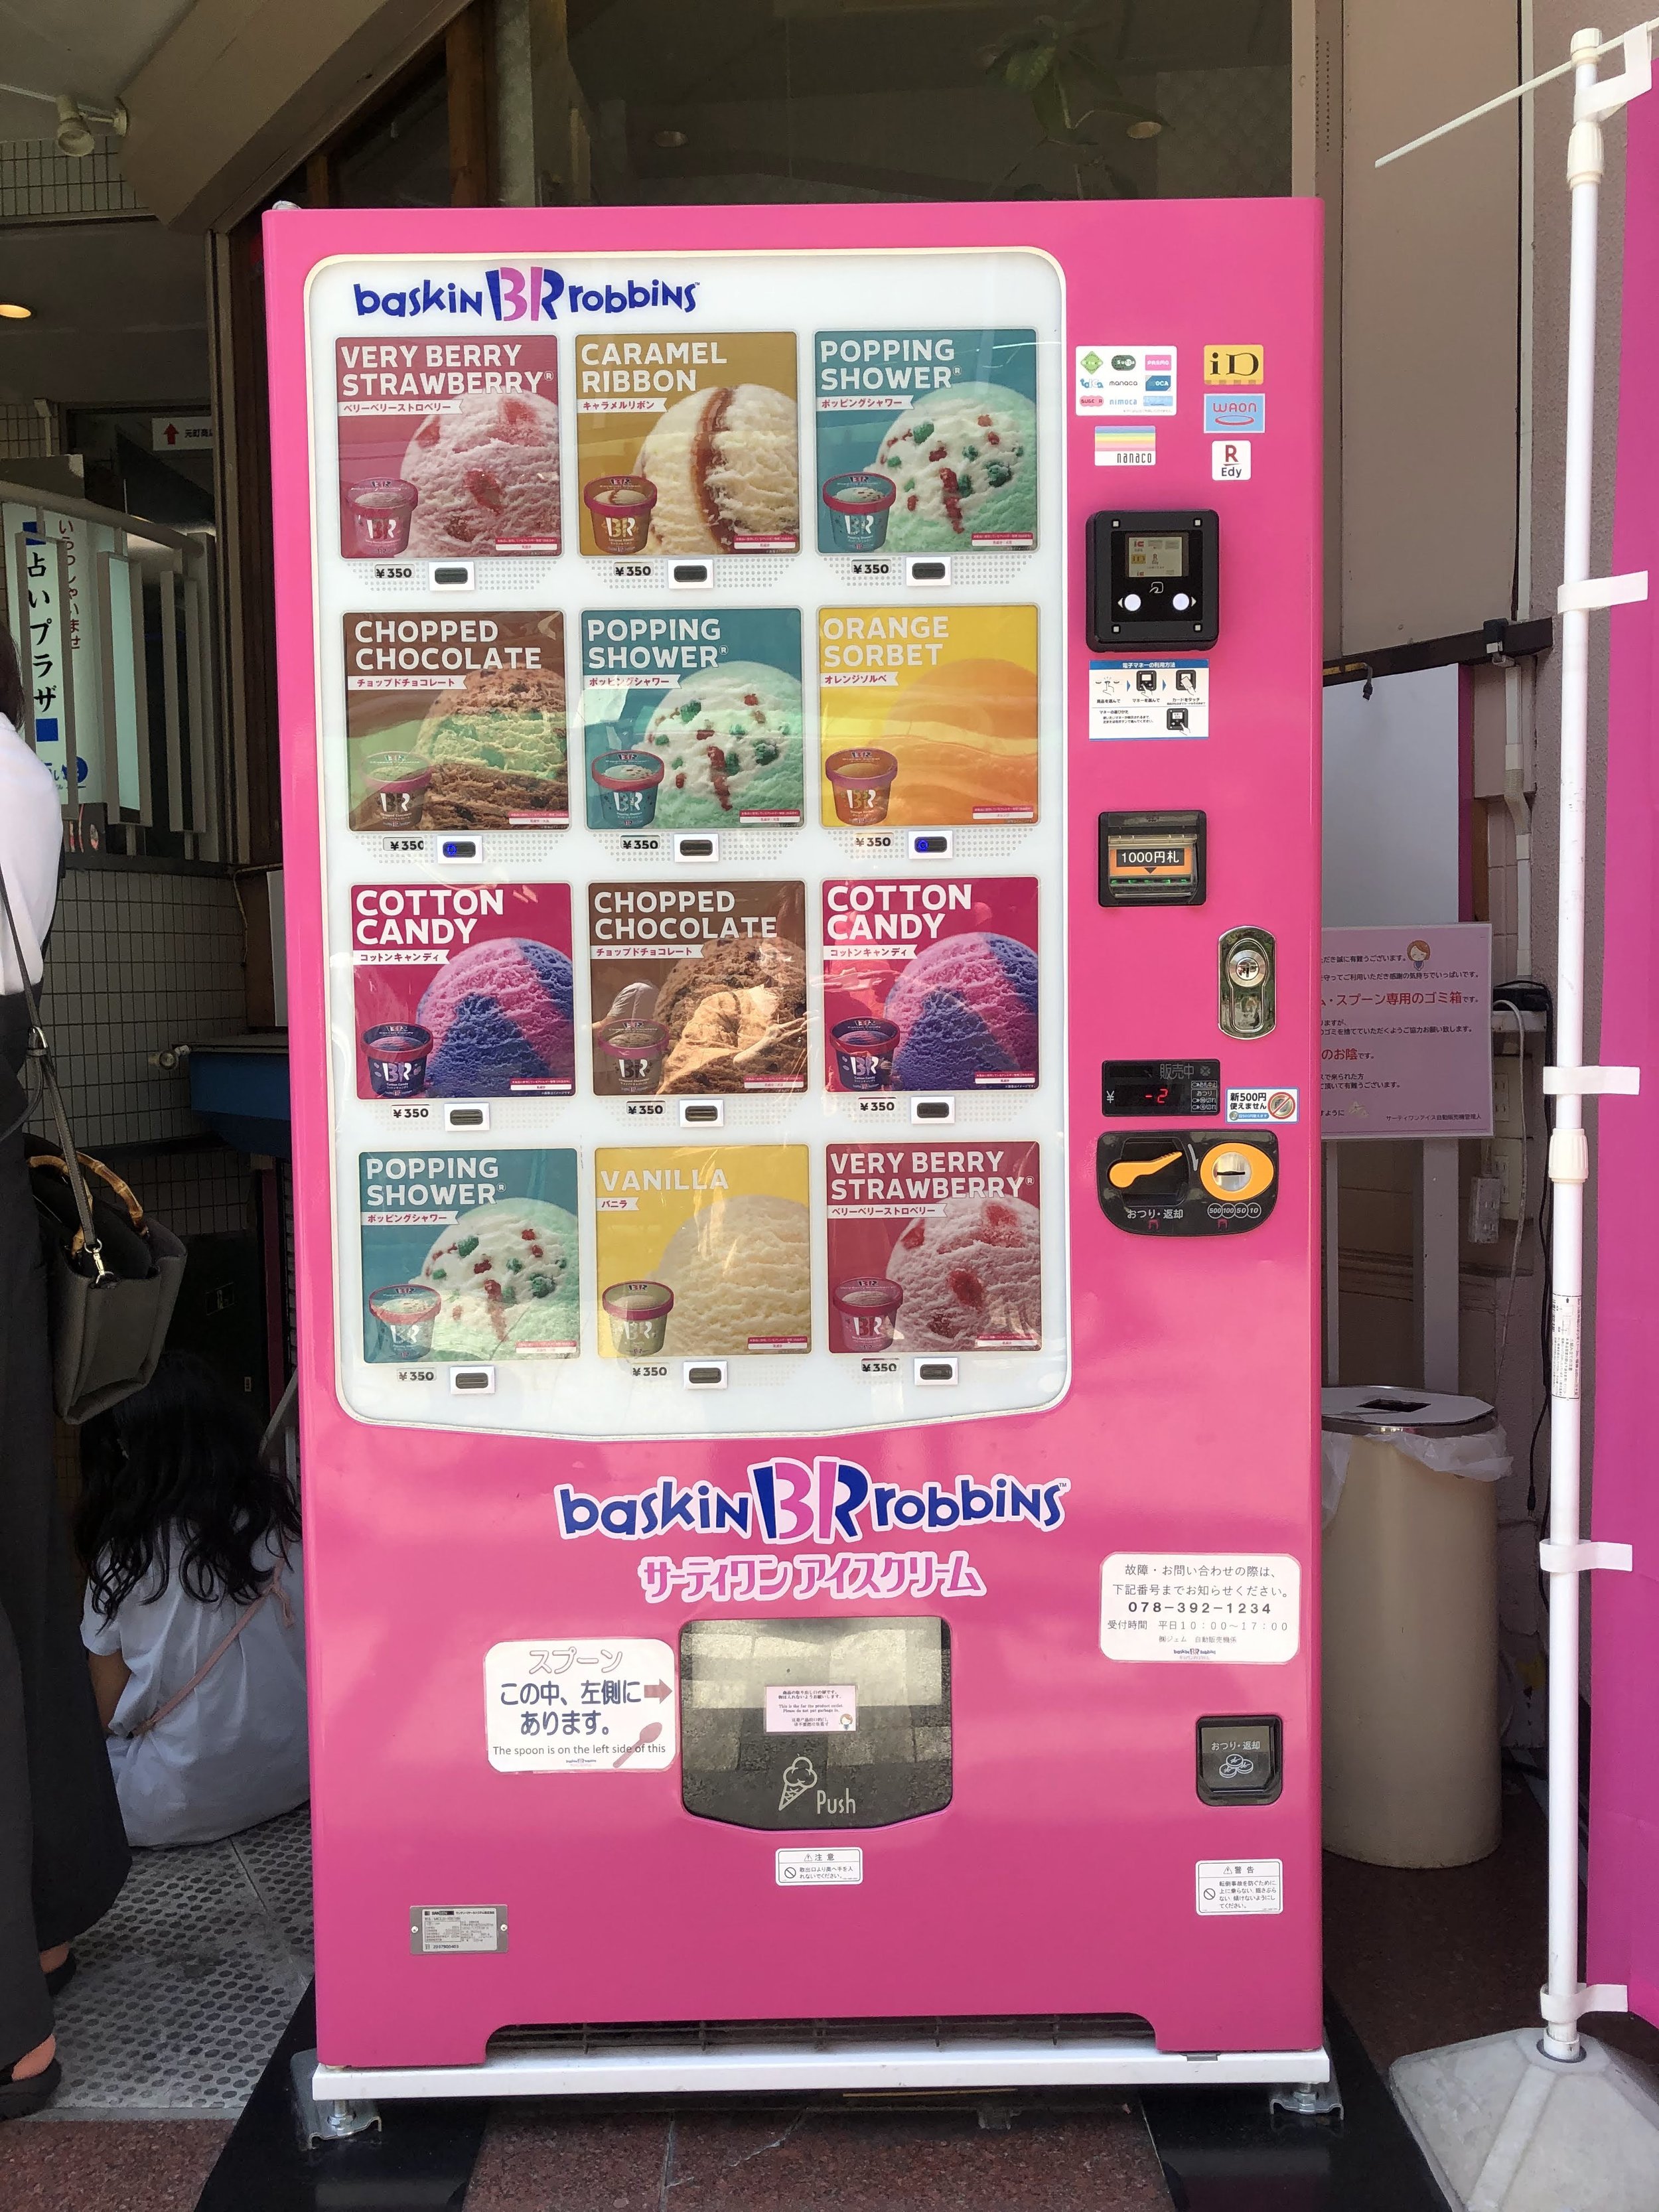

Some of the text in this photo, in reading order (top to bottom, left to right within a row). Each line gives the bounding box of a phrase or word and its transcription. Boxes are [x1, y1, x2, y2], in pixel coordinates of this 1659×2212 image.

[354, 279, 482, 317] baskin
[485, 266, 564, 321] BR
[341, 344, 522, 368] VERY BERRY
[581, 342, 727, 365] CARAMEL
[820, 338, 955, 362] POPPING
[1210, 352, 1259, 376] iD
[582, 369, 697, 393] RIBBON
[343, 402, 451, 412] ベリーベリーストロベリー
[583, 401, 654, 411] キャラメルリボン
[821, 398, 902, 408] ポッピングシャワー
[1213, 402, 1257, 413] WAON
[1117, 453, 1152, 463] nanaco
[1225, 445, 1239, 463] R
[1221, 467, 1242, 478] Edy
[376, 567, 412, 578] ¥350
[615, 565, 651, 577] ¥350
[853, 564, 889, 574] ¥350
[27, 552, 56, 713] 占いプラザ
[355, 620, 498, 643] CHOPPED
[587, 619, 721, 642] POPPING
[824, 616, 949, 639] ORANGE
[355, 647, 542, 671] CHOCOLATE
[824, 643, 943, 667] SORBET
[357, 678, 455, 688] チョップドチョコレート
[589, 678, 670, 686] ポッピングシャワー
[824, 674, 887, 684] オレンジソルベ
[623, 840, 658, 849] ¥350
[855, 837, 891, 847] ¥350
[1121, 850, 1179, 863] 1000円札
[356, 889, 504, 916] COTTON
[595, 891, 735, 913] CHOPPED
[827, 884, 972, 911] COTTON
[356, 919, 478, 944] CANDY
[595, 917, 777, 940] CHOCOLATE
[827, 913, 946, 940] CANDY
[360, 952, 439, 962] コットンキャンディ
[597, 948, 692, 957] チョップドチョコレート
[831, 948, 907, 957] コットンキャンディ
[1321, 971, 1479, 982] 守ってご利用いただき感謝の気持ちでいっぱいです。
[1159, 1063, 1194, 1080] 販売中
[1230, 1092, 1267, 1102] 新500円
[393, 1108, 429, 1118] ¥350
[628, 1105, 663, 1115] ¥350
[860, 1102, 895, 1112] ¥350
[366, 1157, 498, 1179] POPPING
[830, 1151, 1004, 1174] VERY BERRY
[600, 1169, 728, 1191] VANILLA
[602, 1200, 628, 1209] バニラ
[831, 1206, 936, 1215] ベリーベリーストロベリー
[368, 1214, 447, 1222] ポッピングシャワー
[1127, 1209, 1183, 1219] おつり・返却
[398, 1372, 434, 1381] ¥350
[633, 1366, 668, 1376] ¥350
[559, 1481, 749, 1535] baskin
[752, 1461, 866, 1539] BR
[1125, 1564, 1276, 1578] 故障・お問い合わせの際は、
[1113, 1584, 1288, 1598] 下記番号までお知らせください。
[1128, 1601, 1271, 1614] 078-392-1234
[1107, 1620, 1148, 1631] 受付時間
[529, 1647, 622, 1674] スプーン
[500, 1680, 642, 1706] この中、左側に
[520, 1710, 609, 1735] あります。
[493, 1746, 511, 1755] The
[514, 1747, 544, 1756] spoon
[593, 1745, 609, 1753] left
[648, 1744, 666, 1753] this
[1211, 1740, 1260, 1751] おつり・返却
[817, 1788, 856, 1814] Push
